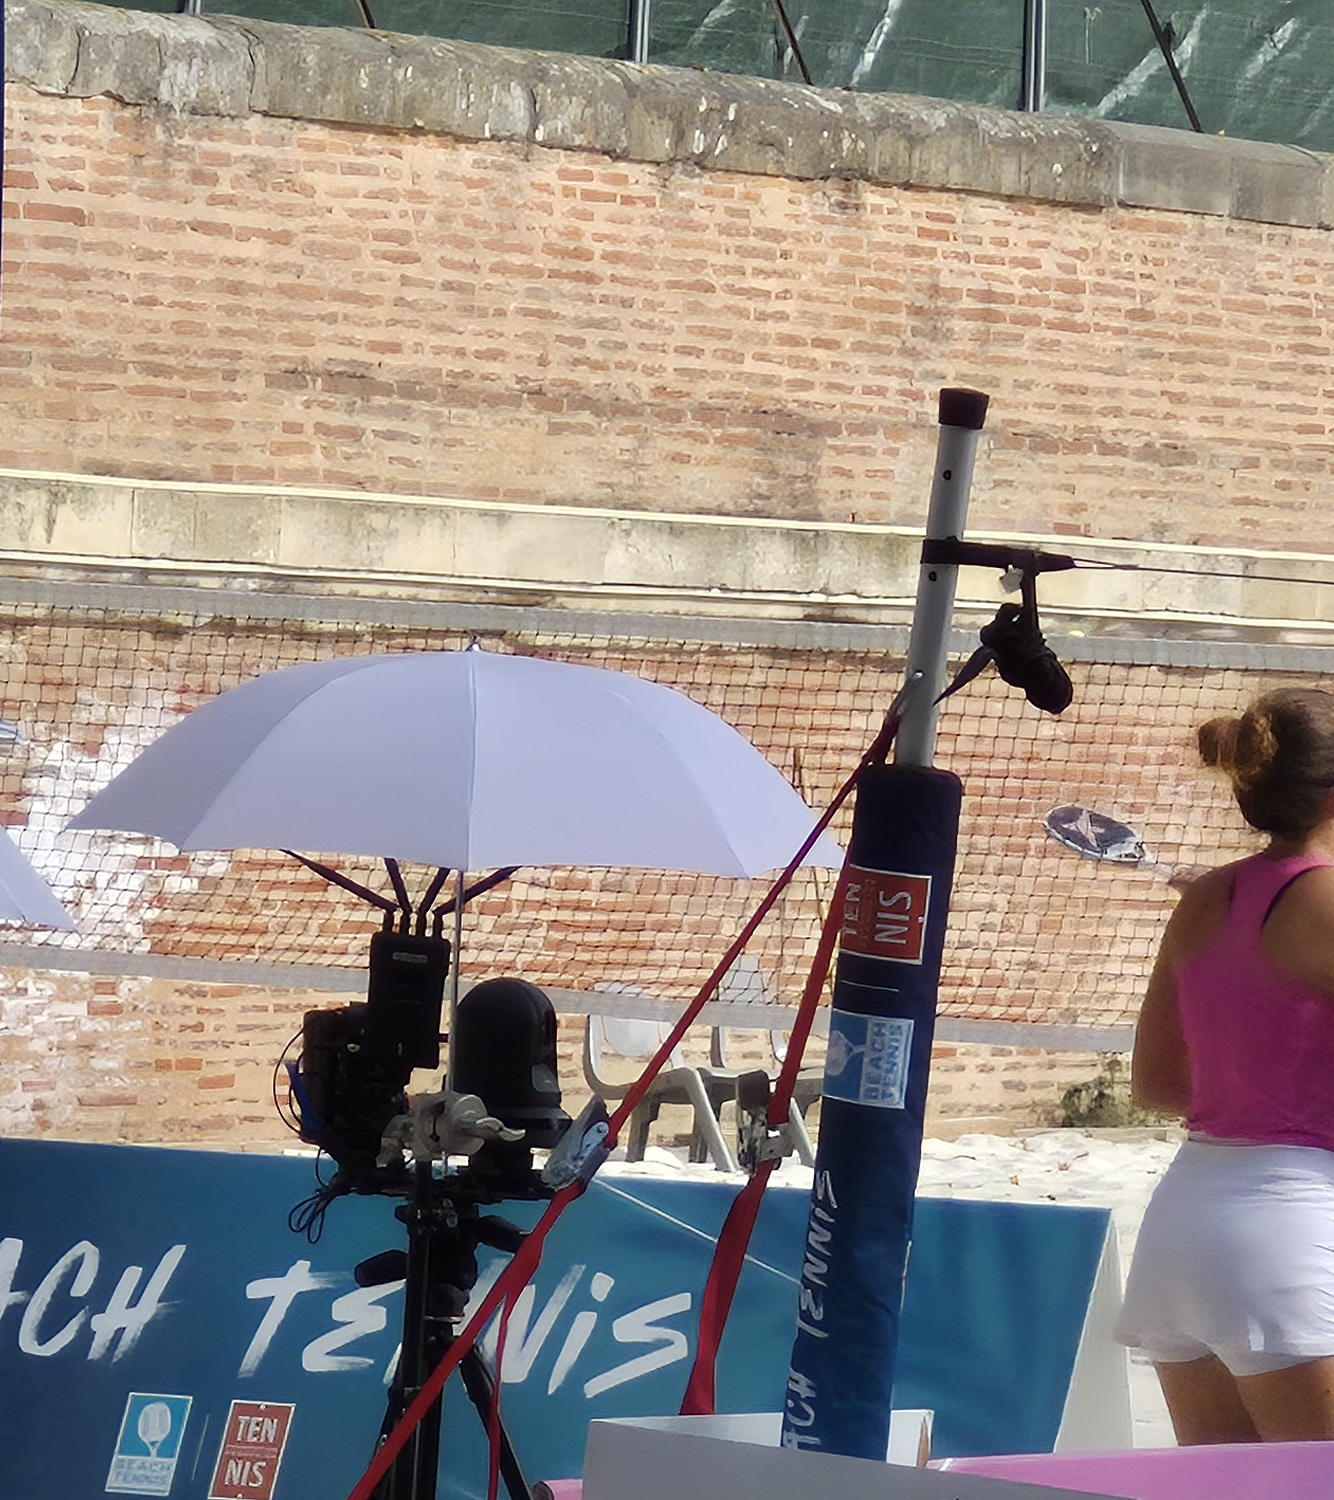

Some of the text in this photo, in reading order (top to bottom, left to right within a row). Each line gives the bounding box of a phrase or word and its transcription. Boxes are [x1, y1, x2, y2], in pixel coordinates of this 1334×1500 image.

[874, 890, 912, 945] NIS
[236, 1415, 279, 1443] TEN
[225, 1459, 267, 1488] NIS
